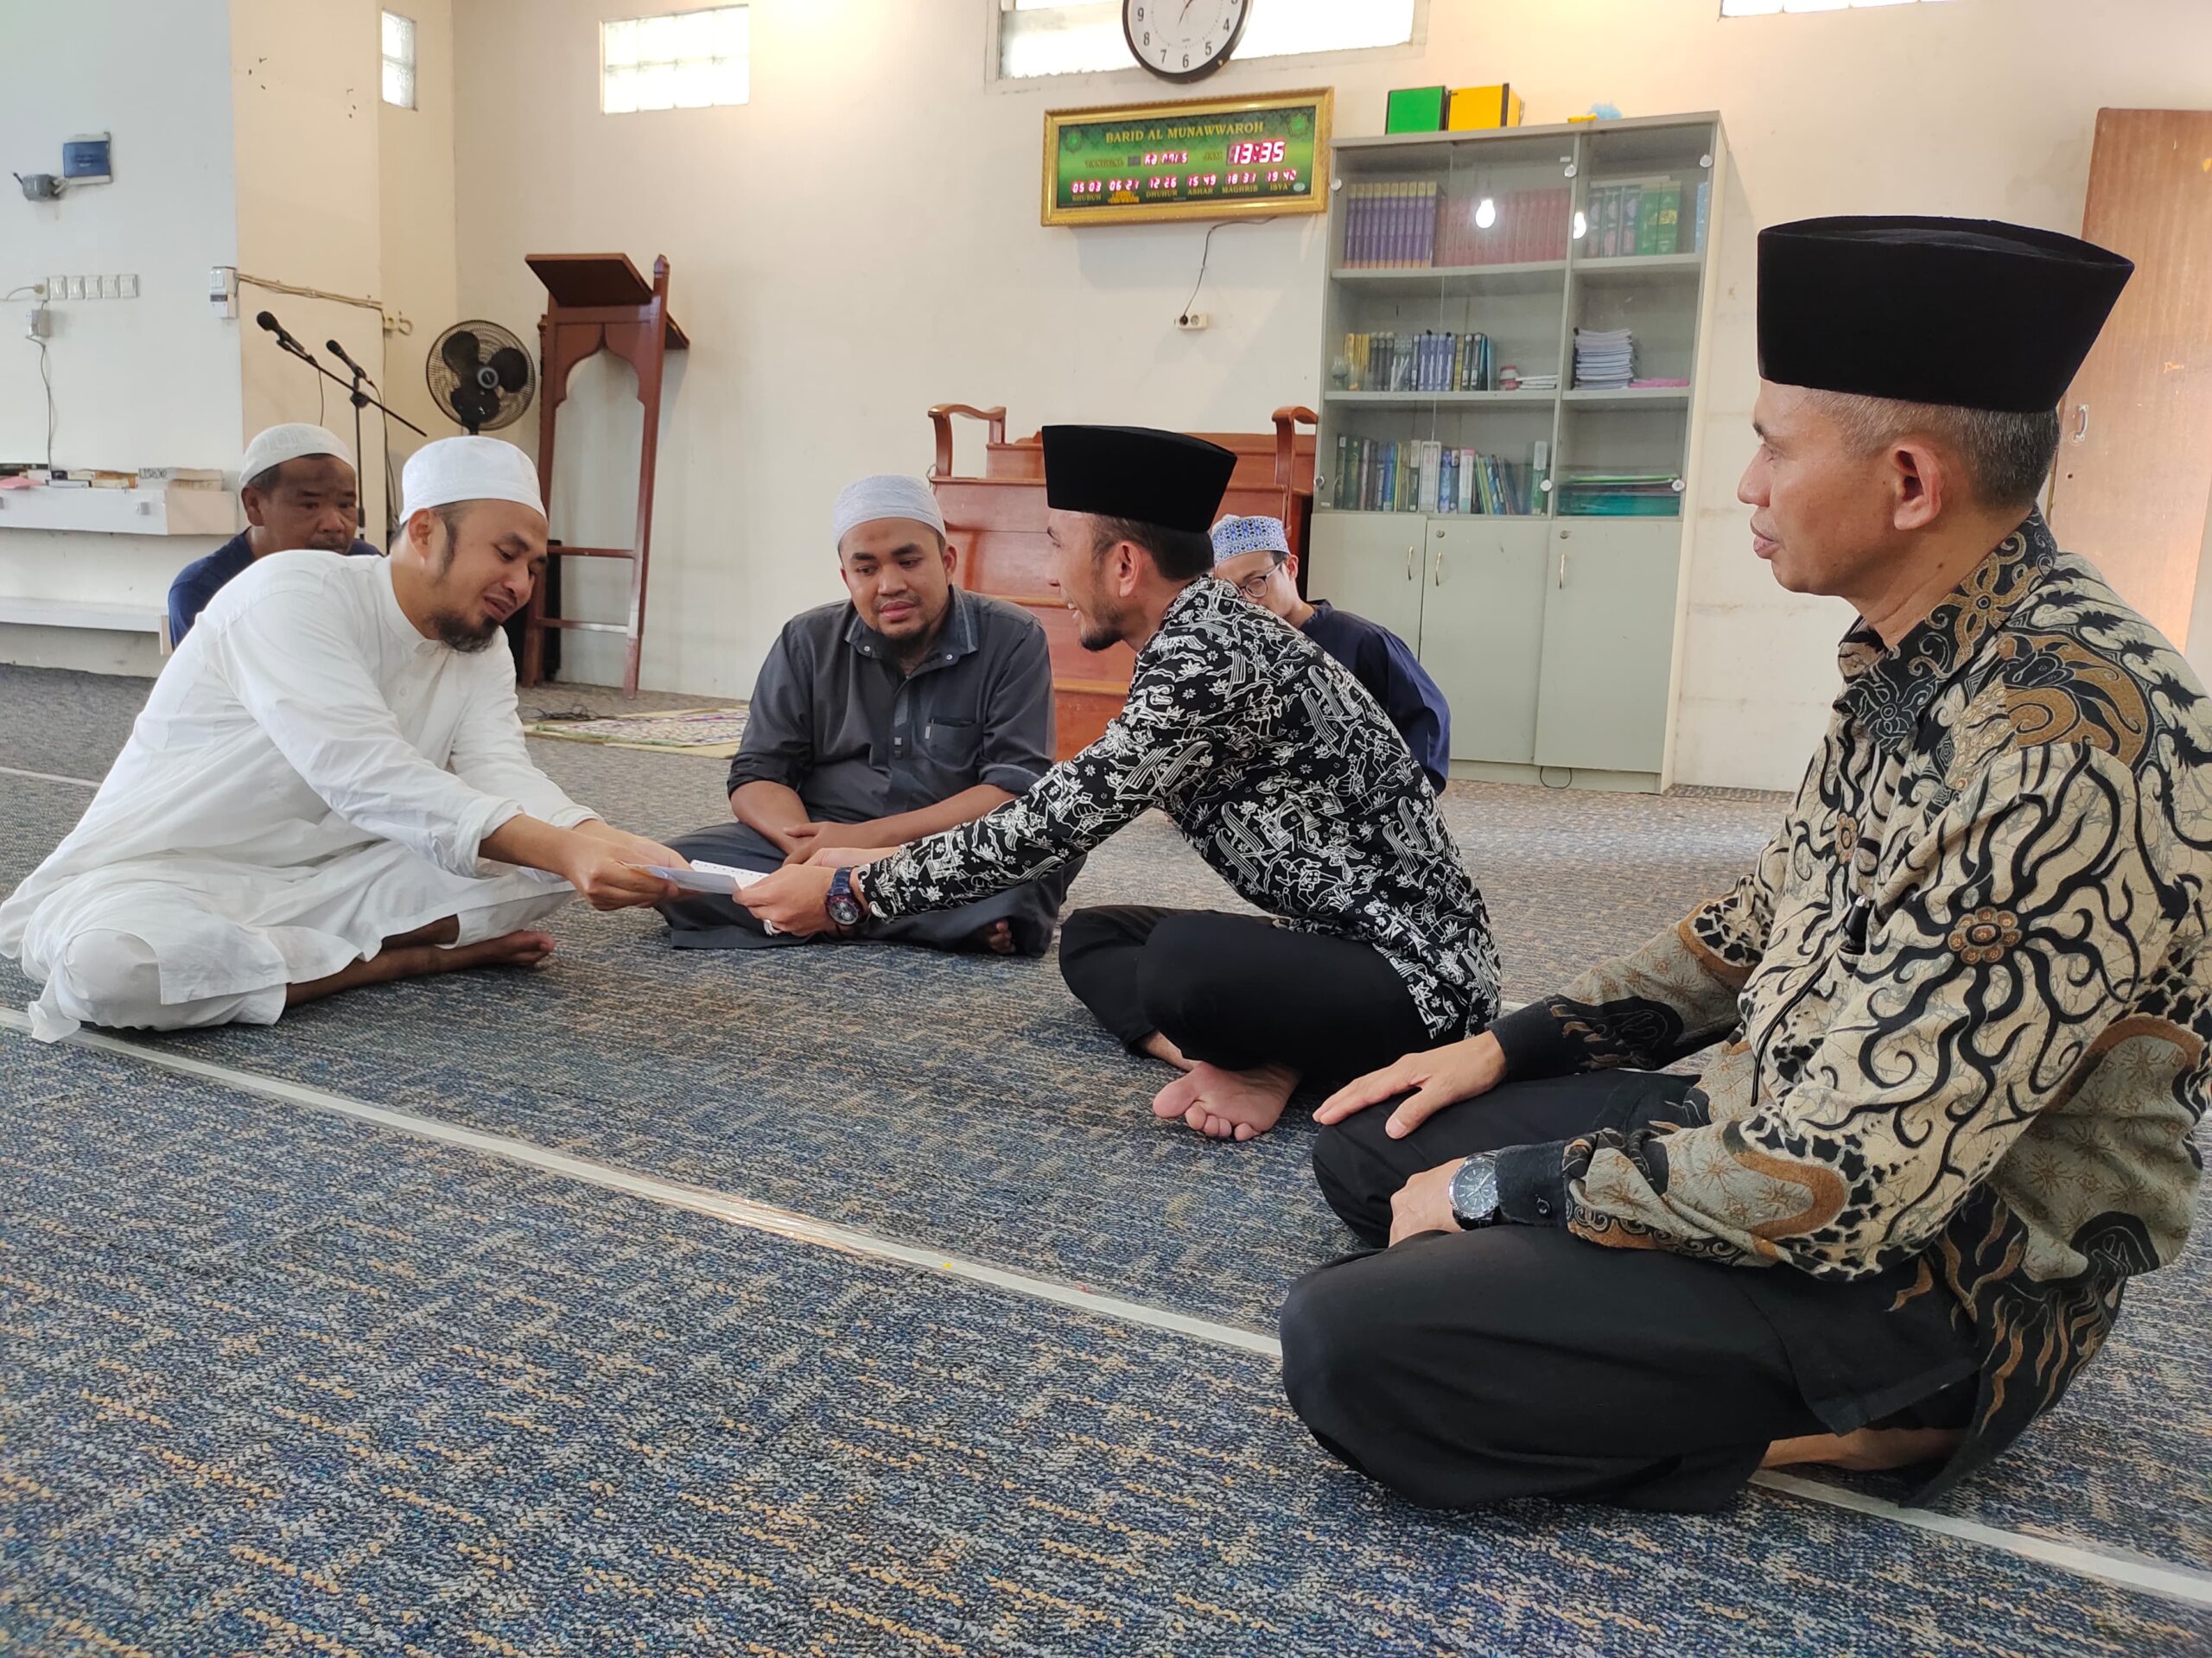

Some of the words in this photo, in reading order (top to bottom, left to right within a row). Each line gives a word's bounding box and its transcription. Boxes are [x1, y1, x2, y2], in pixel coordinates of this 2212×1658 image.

[1137, 7, 1144, 22] 9
[1223, 18, 1230, 32] 4
[1143, 32, 1150, 46] 8
[1205, 41, 1212, 55] 5
[1160, 49, 1167, 64] 7
[1182, 54, 1189, 68] 6
[1105, 130, 1144, 143] BARID
[1147, 129, 1163, 140] AL
[1167, 121, 1265, 139] MUNAWWAROH
[1233, 140, 1286, 165] 13:35
